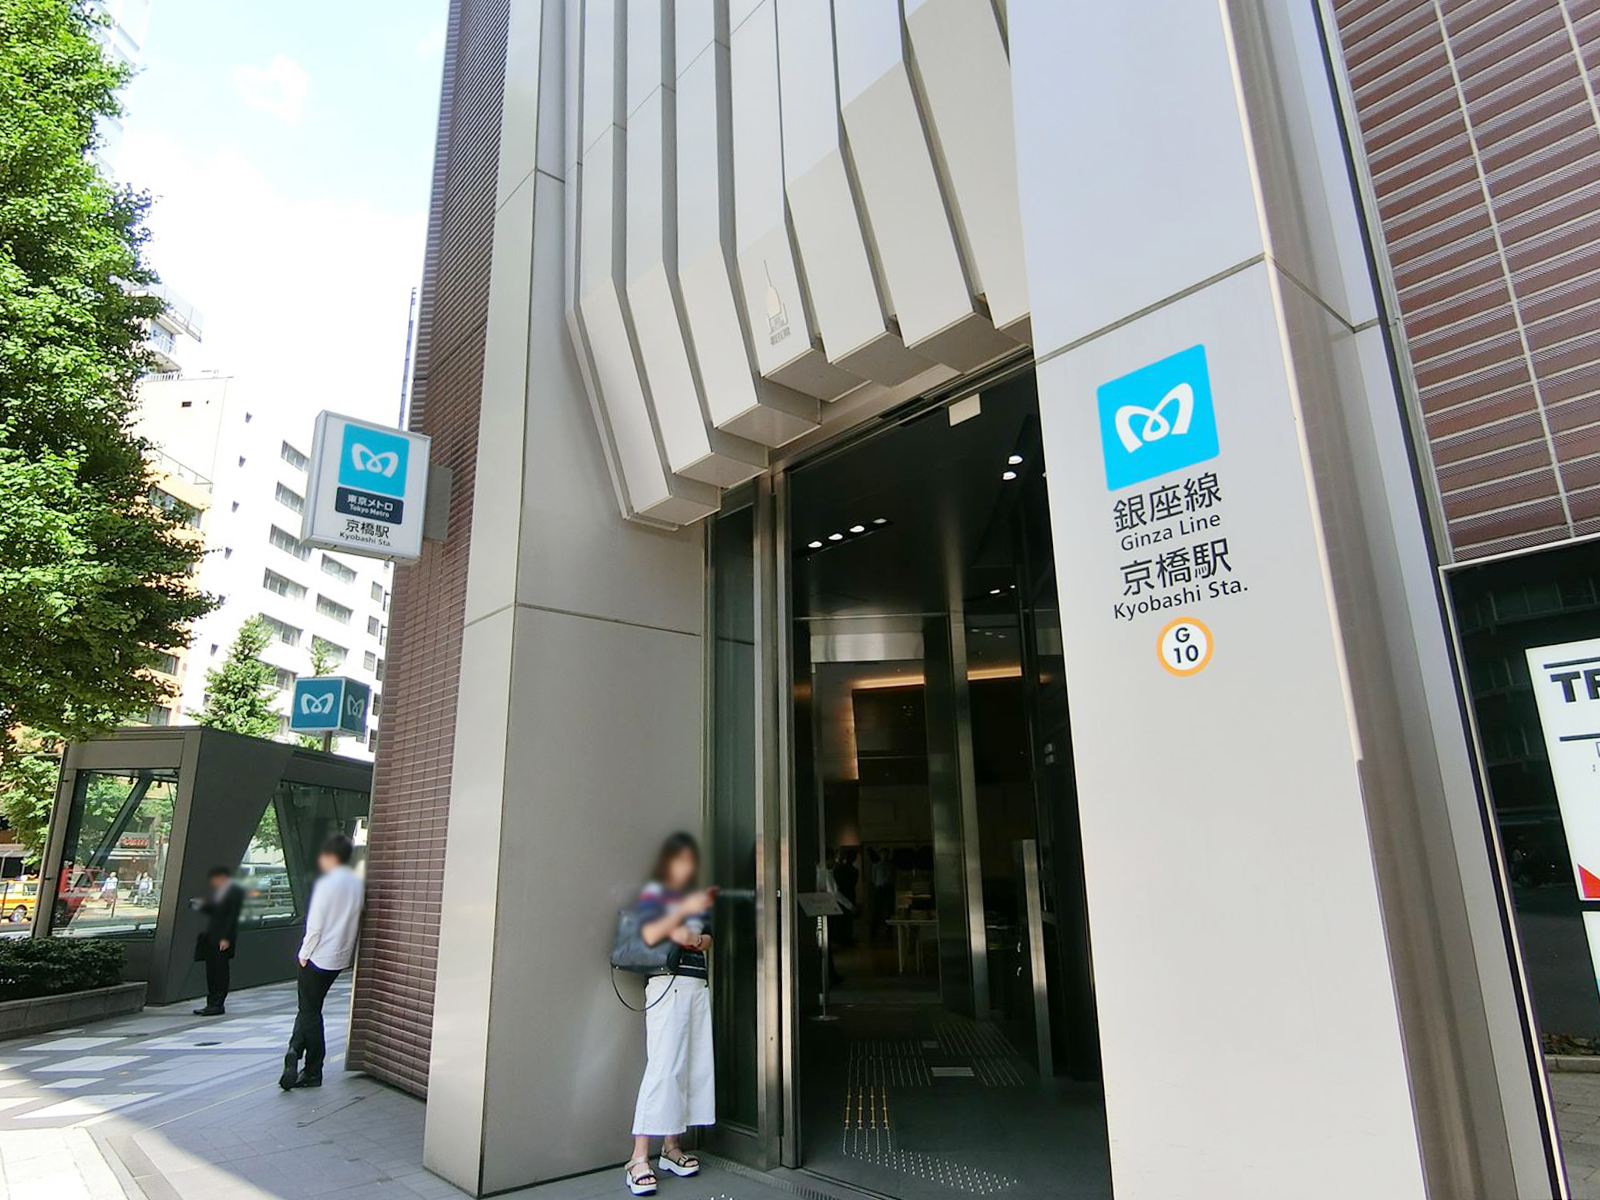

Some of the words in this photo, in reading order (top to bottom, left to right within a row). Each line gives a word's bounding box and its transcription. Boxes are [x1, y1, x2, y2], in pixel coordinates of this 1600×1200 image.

[347, 494, 393, 511] 東京メトロ
[350, 503, 369, 514] Tokyo
[370, 508, 390, 518] Metro
[1113, 472, 1222, 533] 銀座線
[340, 532, 376, 543] Kyobashi
[345, 519, 390, 539] 京橋駅
[1121, 528, 1173, 551] Ginza
[1180, 514, 1221, 536] Line
[1119, 538, 1232, 596] 京橋駅
[1114, 585, 1201, 621] Kyobashi
[1210, 580, 1248, 599] Sta.
[1175, 627, 1190, 643] G
[1173, 644, 1199, 664] 10
